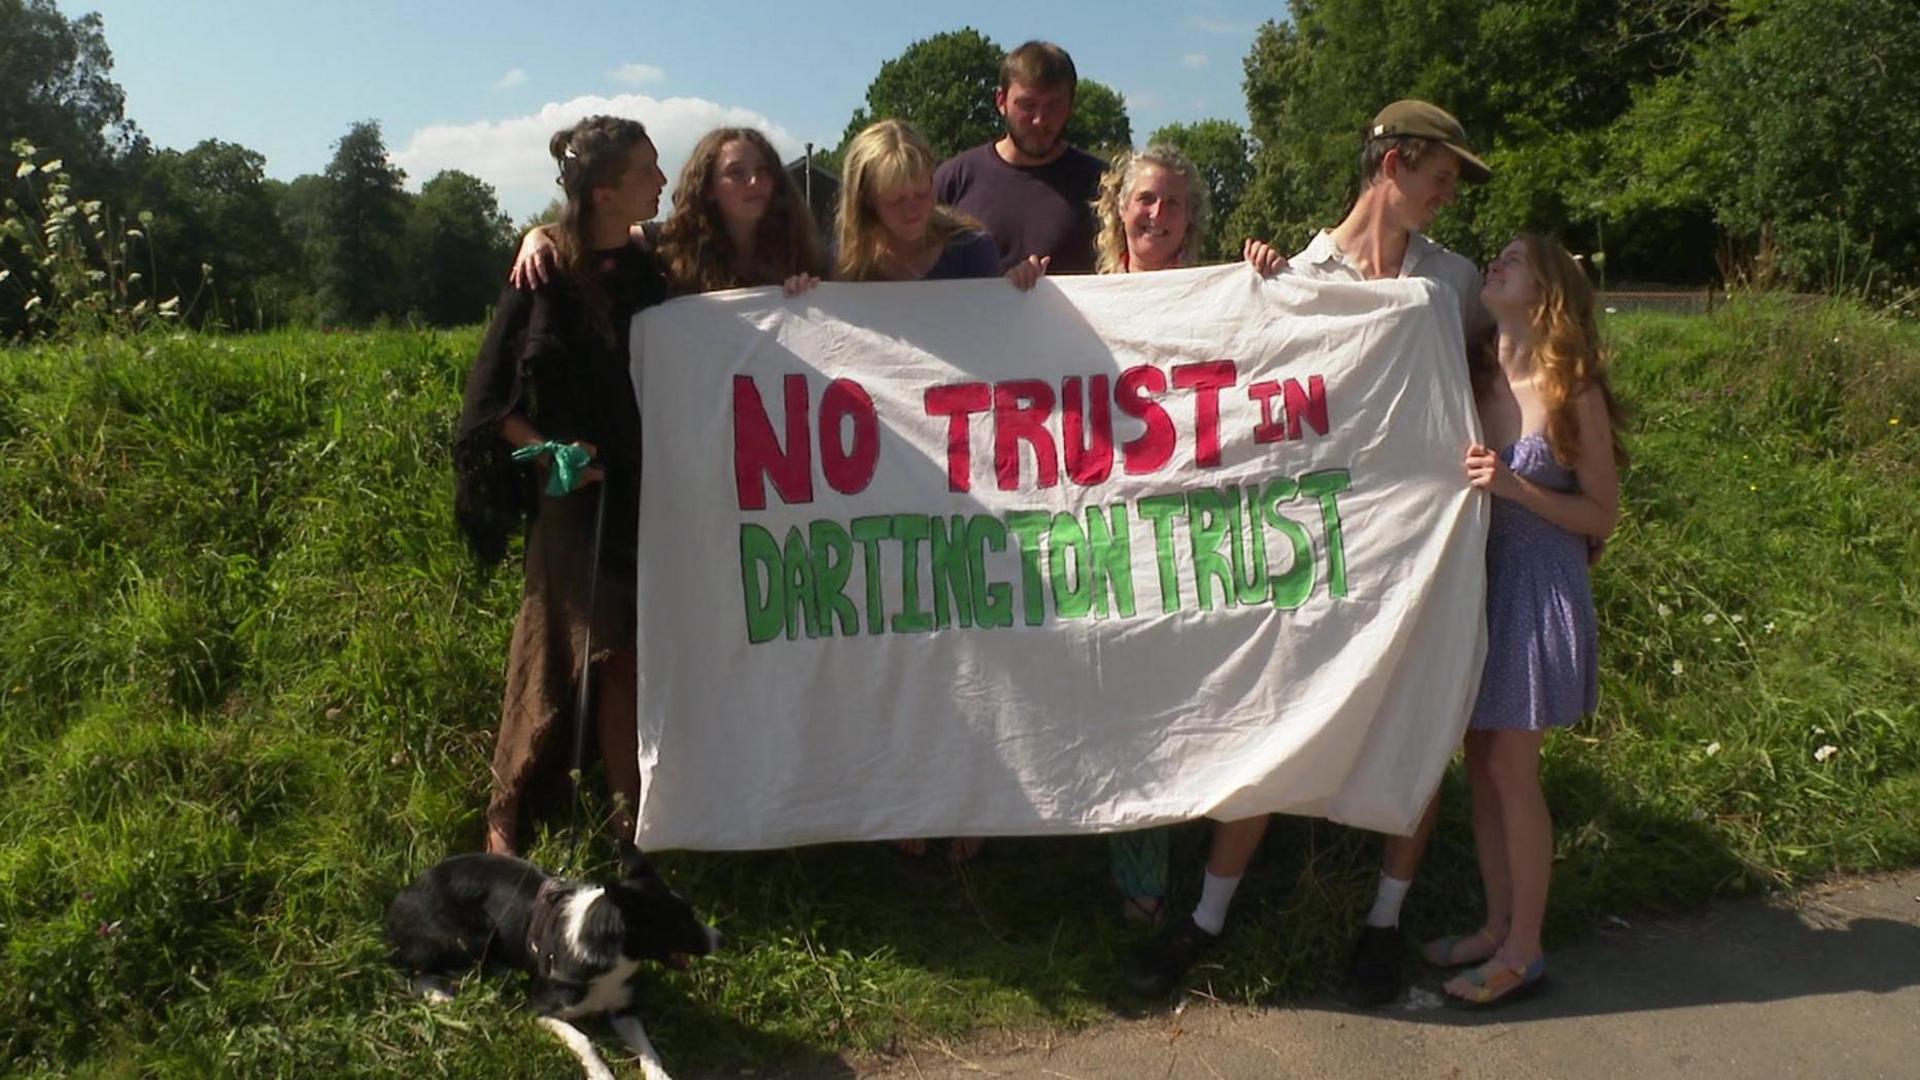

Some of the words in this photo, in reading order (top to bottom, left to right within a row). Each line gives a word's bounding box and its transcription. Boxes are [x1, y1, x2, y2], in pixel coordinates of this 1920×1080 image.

[733, 374, 880, 510] NO
[924, 360, 1236, 492] TRUST
[1248, 375, 1331, 445] IN
[740, 503, 1136, 643] DARTINGTON
[1138, 468, 1352, 611] TRUST
